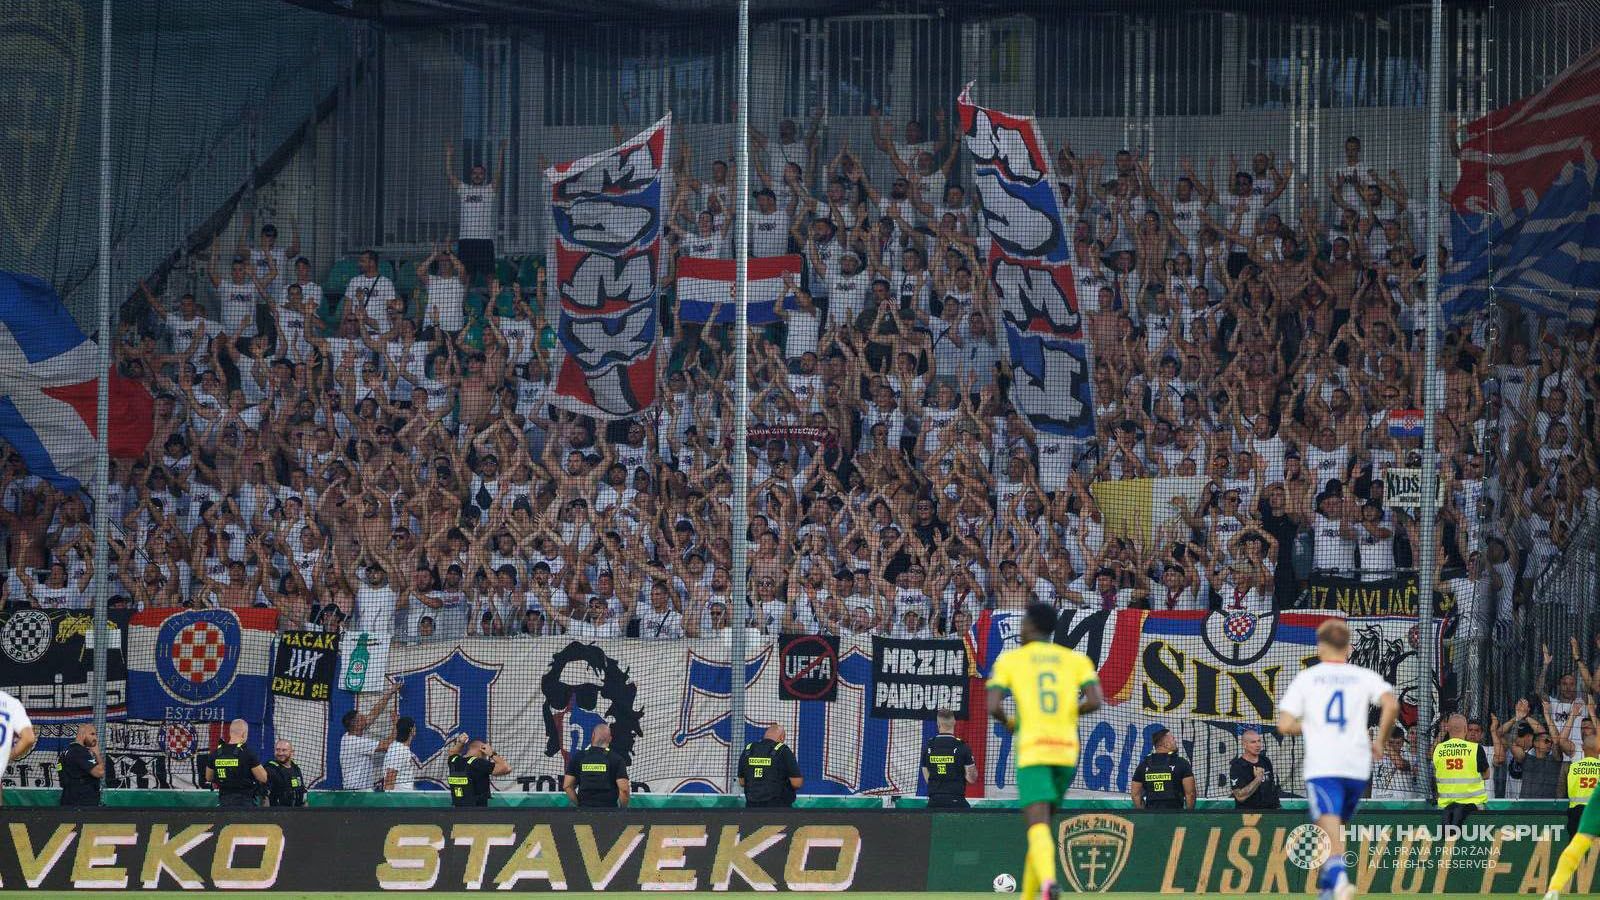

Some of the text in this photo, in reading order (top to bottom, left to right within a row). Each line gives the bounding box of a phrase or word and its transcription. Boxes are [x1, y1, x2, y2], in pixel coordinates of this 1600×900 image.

[9, 646, 40, 660] SPLIT
[881, 647, 964, 676] MRZIN
[785, 655, 831, 680] UEFA
[271, 676, 329, 699] DRŽI SE
[875, 681, 963, 711] PANDURE
[1037, 671, 1059, 715] 6
[200, 706, 225, 720] 1911
[1325, 688, 1348, 734] 4
[1438, 749, 1472, 758] SECURITY
[1445, 758, 1464, 770] 58
[1580, 777, 1597, 789] 52
[0, 823, 861, 891] VEKO STAVEKO
